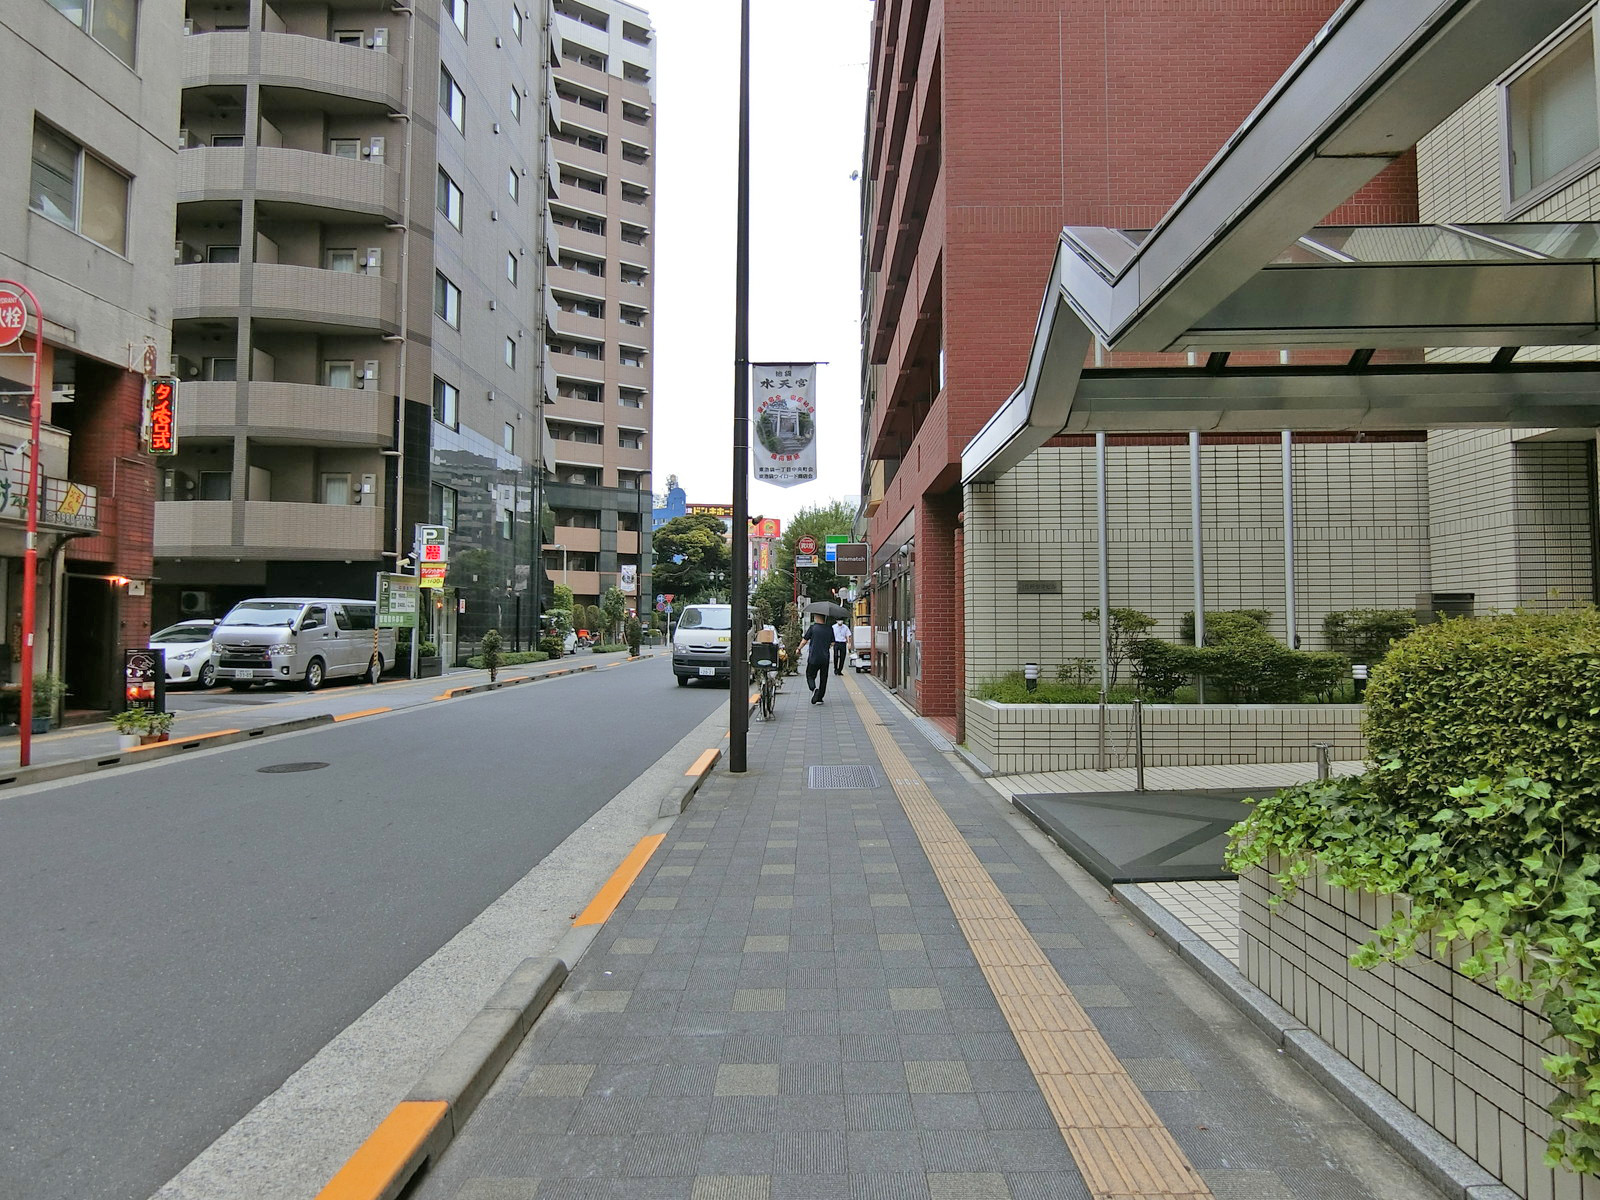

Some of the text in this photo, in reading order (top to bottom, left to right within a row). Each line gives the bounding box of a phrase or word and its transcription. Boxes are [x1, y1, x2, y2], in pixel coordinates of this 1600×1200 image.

[760, 378, 808, 389] 水天宮
[423, 529, 438, 545] P
[382, 581, 389, 592] P
